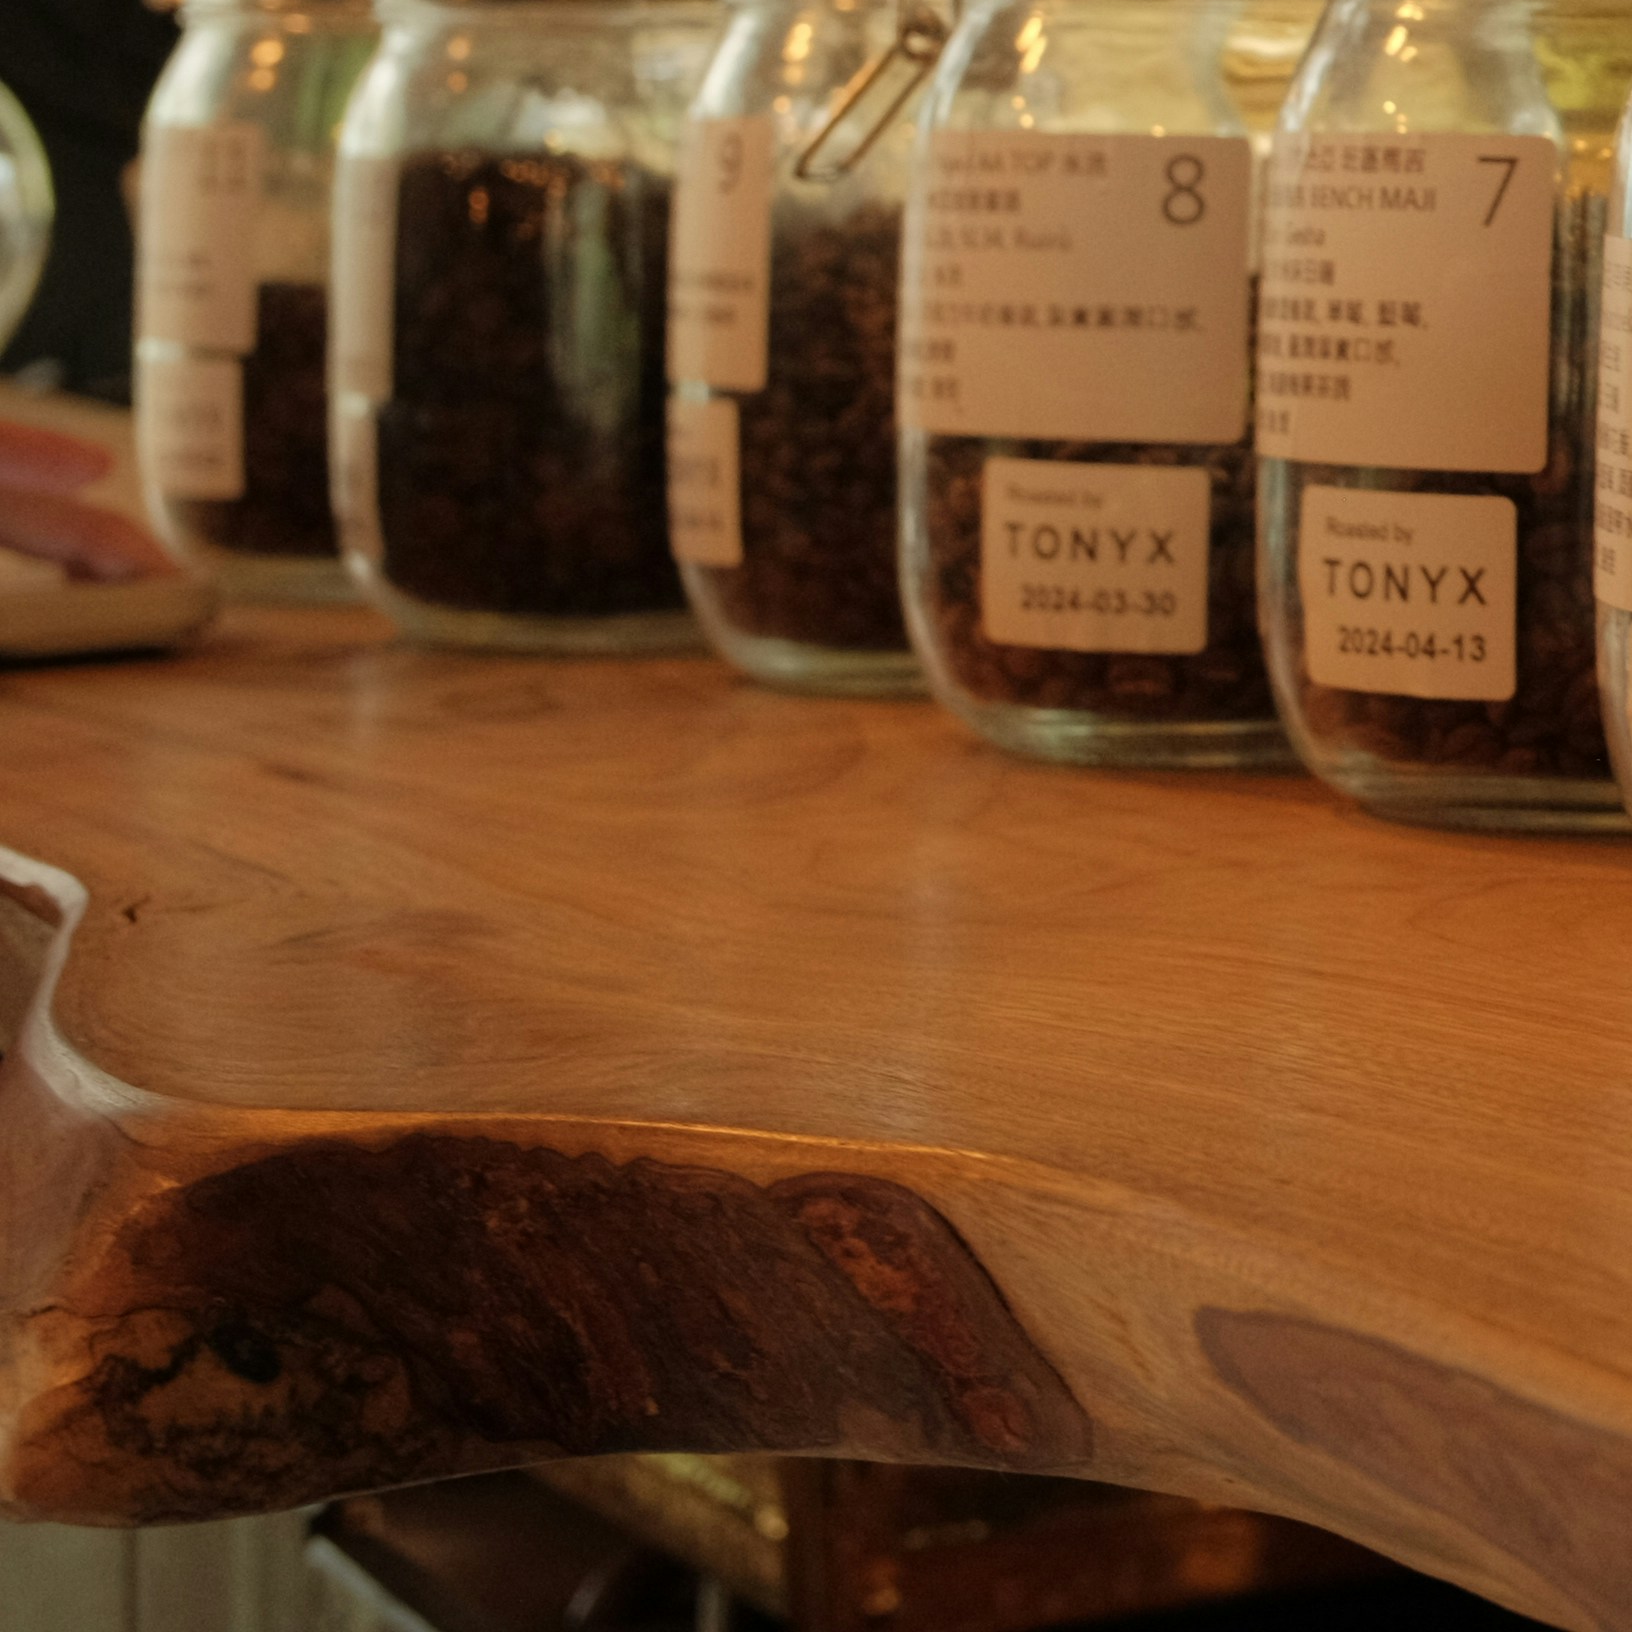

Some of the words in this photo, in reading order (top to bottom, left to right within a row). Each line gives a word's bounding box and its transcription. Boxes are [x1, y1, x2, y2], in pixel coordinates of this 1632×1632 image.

[1162, 152, 1208, 228] 8
[1475, 154, 1521, 228] 7
[1002, 519, 1176, 566] TONYX
[1393, 522, 1414, 546] by
[1322, 556, 1487, 607] TONYX
[1338, 624, 1487, 663] 2024-04-13
